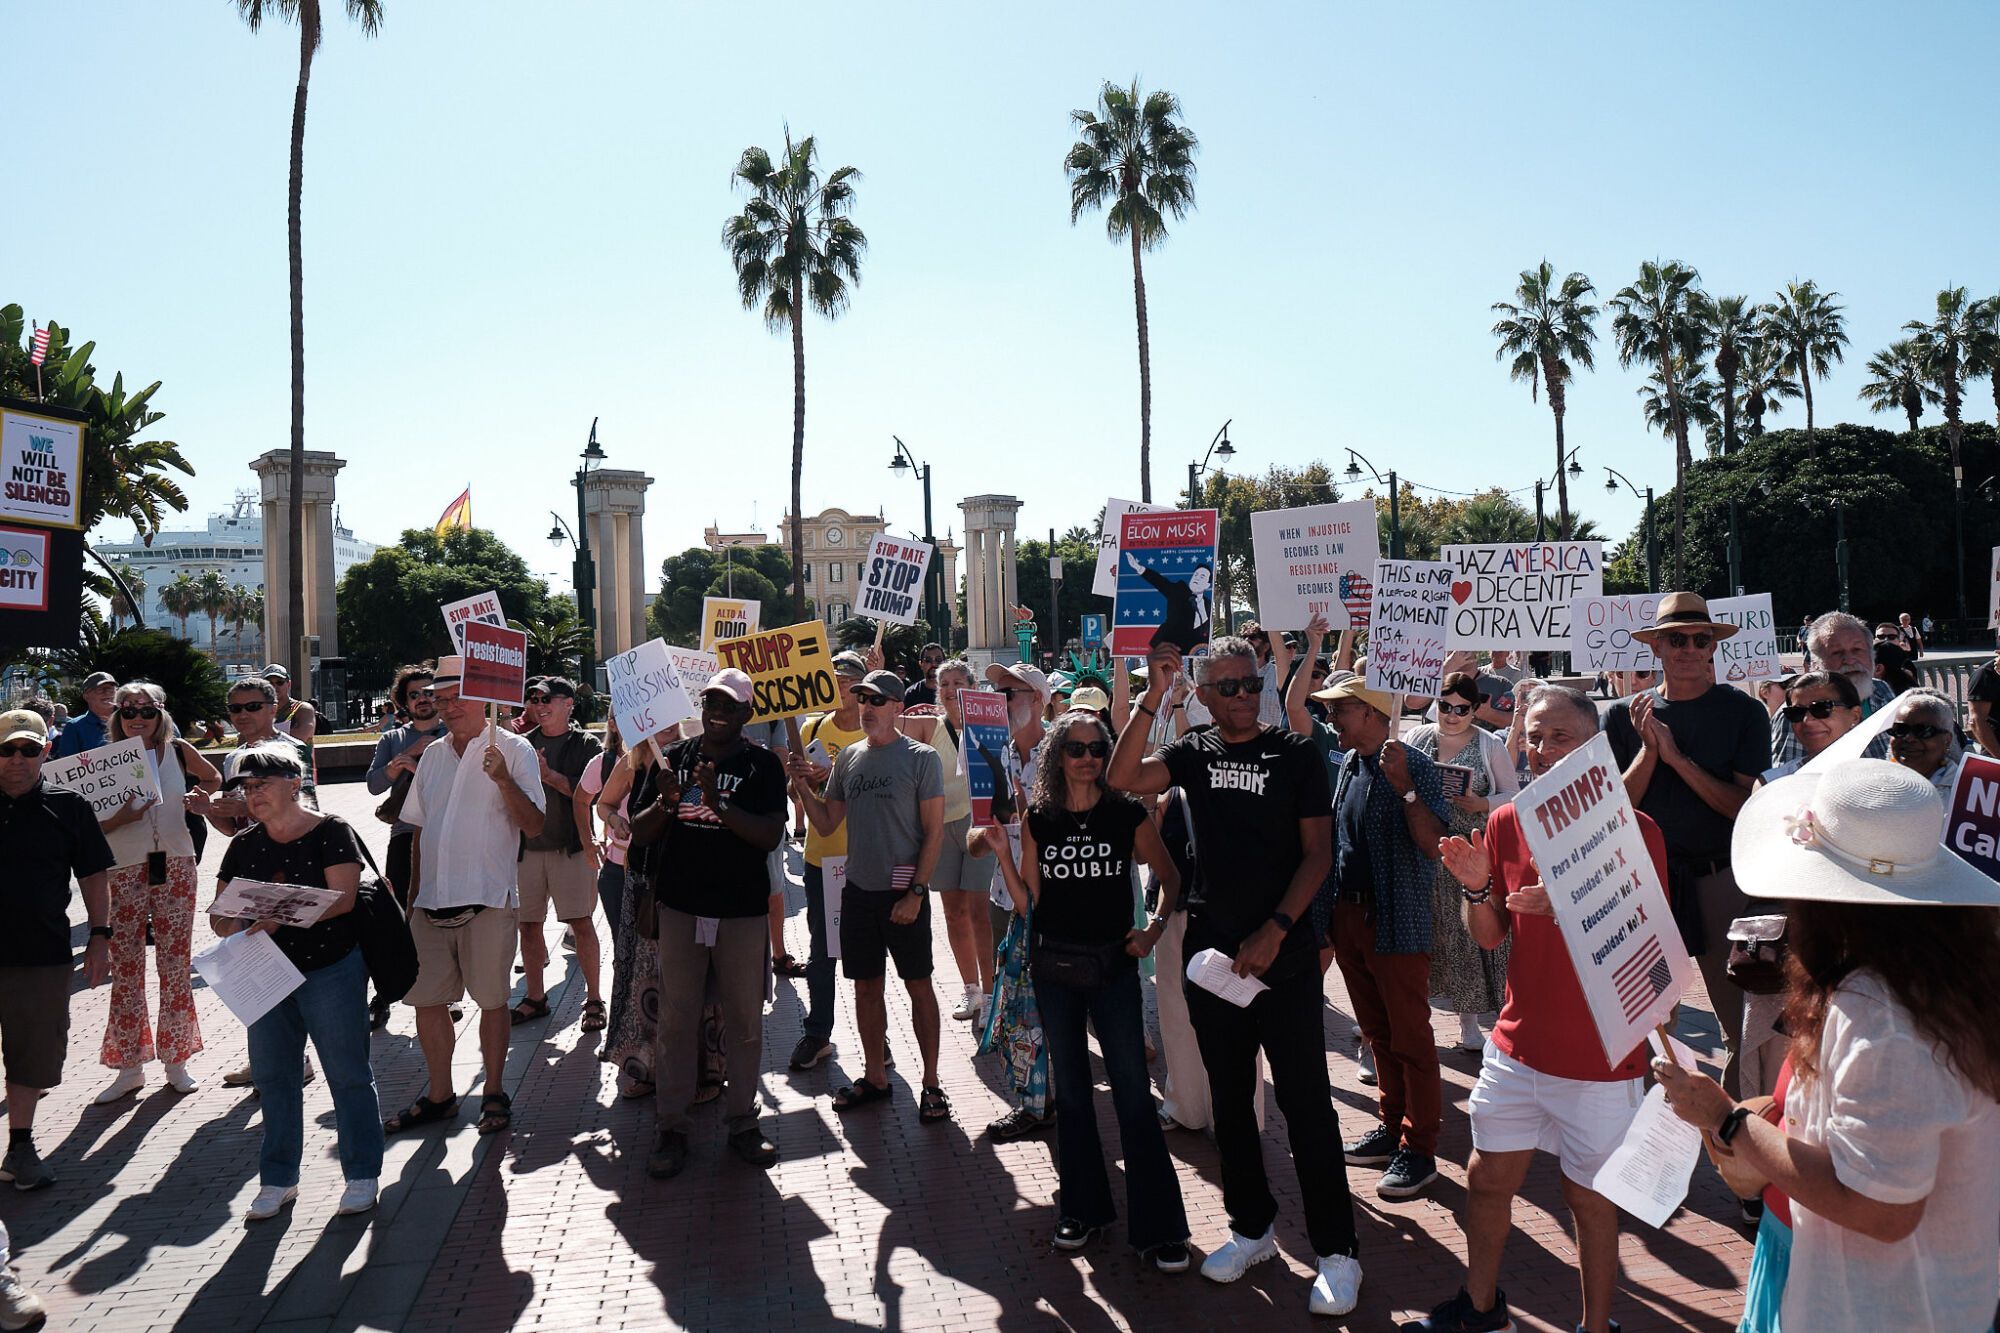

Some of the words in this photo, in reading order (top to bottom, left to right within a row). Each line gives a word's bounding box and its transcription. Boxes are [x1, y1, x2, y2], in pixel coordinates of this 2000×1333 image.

[29, 434, 54, 453] WE
[21, 450, 59, 469] WILL
[12, 466, 43, 483] NOT
[46, 470, 67, 488] BE
[4, 481, 71, 507] SILENCED
[1127, 525, 1160, 540] ELON
[1166, 522, 1207, 538] MUSK
[1279, 527, 1301, 541] WHEN
[1308, 521, 1352, 538] INJUSTICE
[875, 541, 899, 558] STOP
[900, 546, 926, 564] HATE
[1284, 544, 1319, 559] BECOMES
[1326, 542, 1345, 556] LAW
[1447, 549, 1497, 575] HAZ
[1499, 542, 1595, 573] AMÉRICA
[0, 568, 38, 590] CITY
[868, 557, 921, 594] STOP
[1289, 562, 1339, 577] RESISTANCE
[1379, 564, 1412, 584] THIS
[1297, 582, 1334, 595] BECOMES
[1377, 587, 1385, 598] A
[1403, 590, 1418, 598] OR
[1422, 590, 1451, 603] RIGHT
[449, 606, 470, 623] STOP
[472, 599, 496, 616] HATE
[716, 608, 736, 619] ALTO
[738, 610, 747, 619] AL
[863, 586, 914, 617] TRUMP
[1308, 601, 1330, 613] DUTY
[1587, 600, 1656, 627] OMG
[1378, 601, 1449, 627] MOMENT
[1455, 606, 1521, 639] OTRA
[1715, 609, 1766, 634] TURD
[714, 620, 747, 639] ODIO
[1087, 617, 1098, 636] P
[1394, 629, 1404, 640] A
[466, 640, 523, 668] resistencia
[718, 633, 794, 676] TRUMP
[1375, 641, 1401, 668] Right
[1411, 648, 1443, 677] Wrong
[1720, 640, 1776, 663] REICH
[607, 650, 638, 683] STOP
[751, 669, 835, 717] SCISMO
[1378, 668, 1442, 696] MOMENT
[966, 702, 983, 716] ELON
[985, 704, 1005, 718] MUSK
[66, 749, 142, 783] EDUCACIÓN
[1216, 760, 1260, 772] HOWARD
[98, 773, 117, 789] ES
[849, 773, 893, 800] Boise
[1208, 764, 1269, 796] BISON
[1535, 765, 1613, 840] TRUMP:
[1965, 776, 2000, 819] N
[1066, 835, 1080, 843] GET
[1082, 834, 1092, 842] IN
[1551, 857, 1571, 880] Para
[1570, 849, 1580, 863] el
[1581, 827, 1608, 860] pueblo?
[1605, 815, 1620, 834] No!
[1955, 821, 2000, 862] Ca
[1044, 842, 1111, 860] GOOD
[1039, 860, 1122, 879] ROUBLE
[1570, 868, 1604, 905] Sanidad?
[1602, 857, 1617, 877] No!
[1581, 891, 1621, 934] Educación?
[1619, 879, 1633, 899] No!
[1591, 925, 1627, 966] Igualdad?
[1626, 913, 1640, 934] No!
